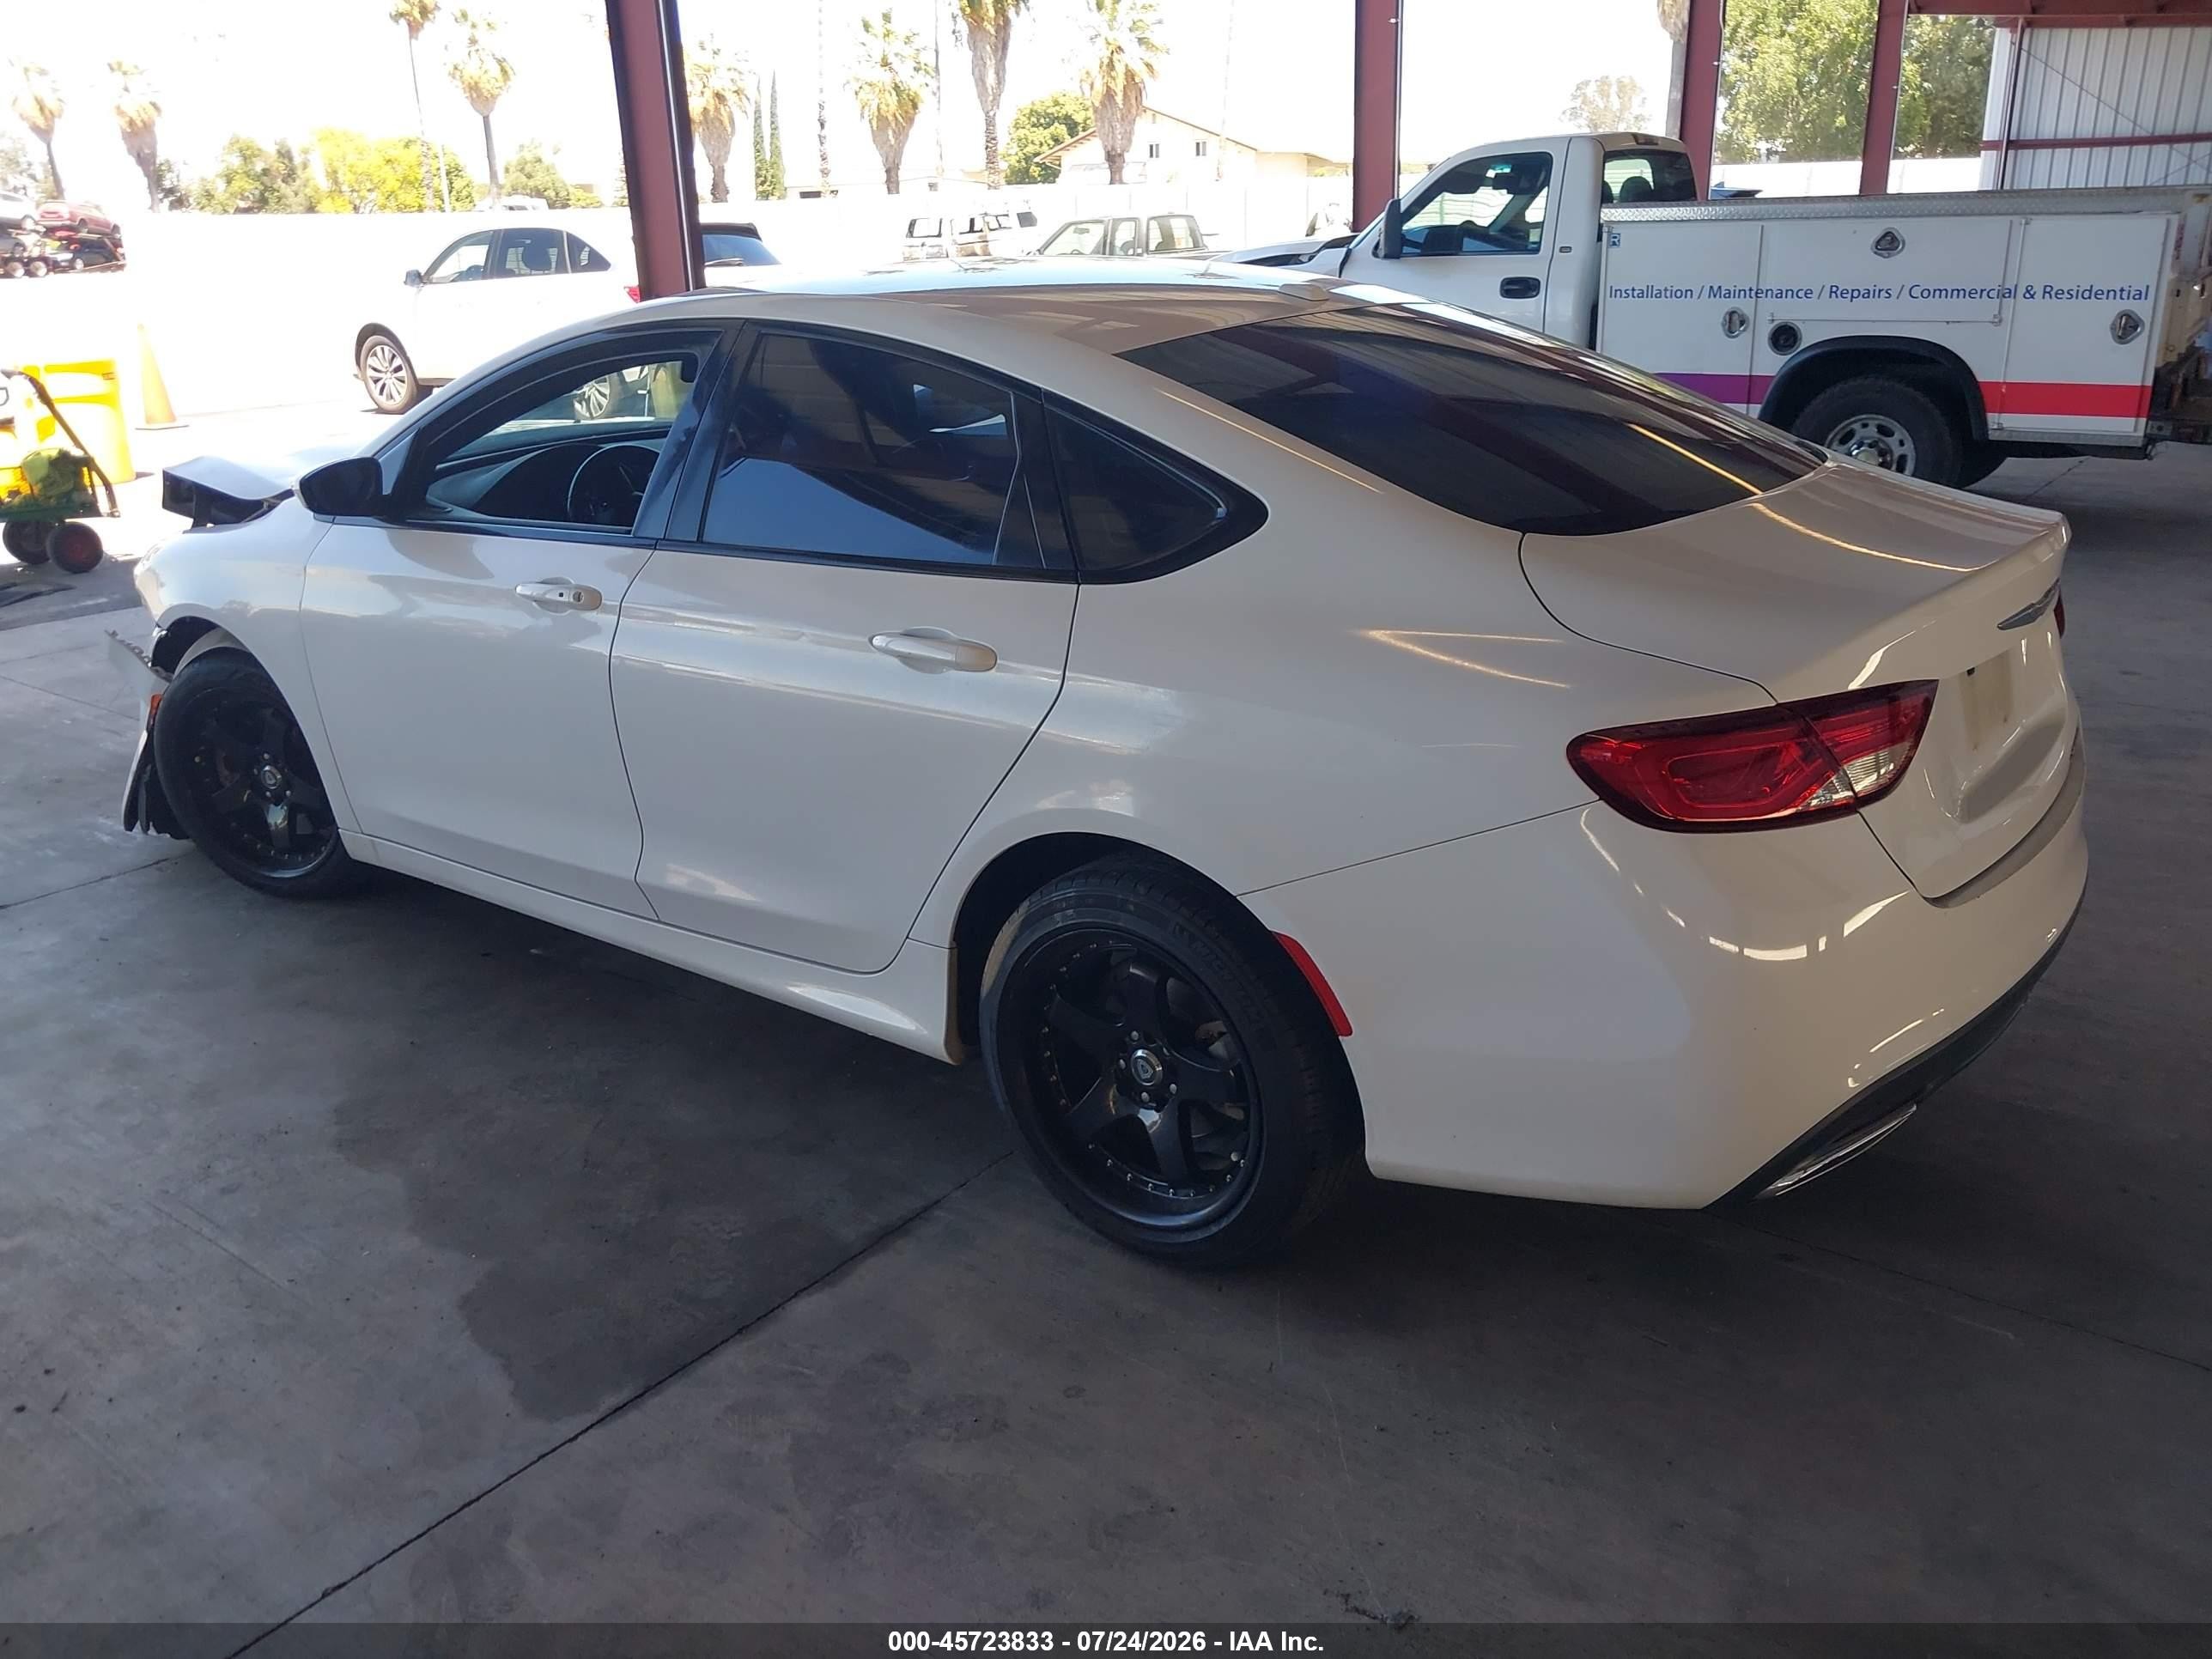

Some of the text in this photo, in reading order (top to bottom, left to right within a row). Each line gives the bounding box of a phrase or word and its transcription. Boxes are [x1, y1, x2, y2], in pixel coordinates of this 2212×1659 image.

[1609, 284, 2149, 302] Installation / Maintenance / Repairs / Commercial & Residential
